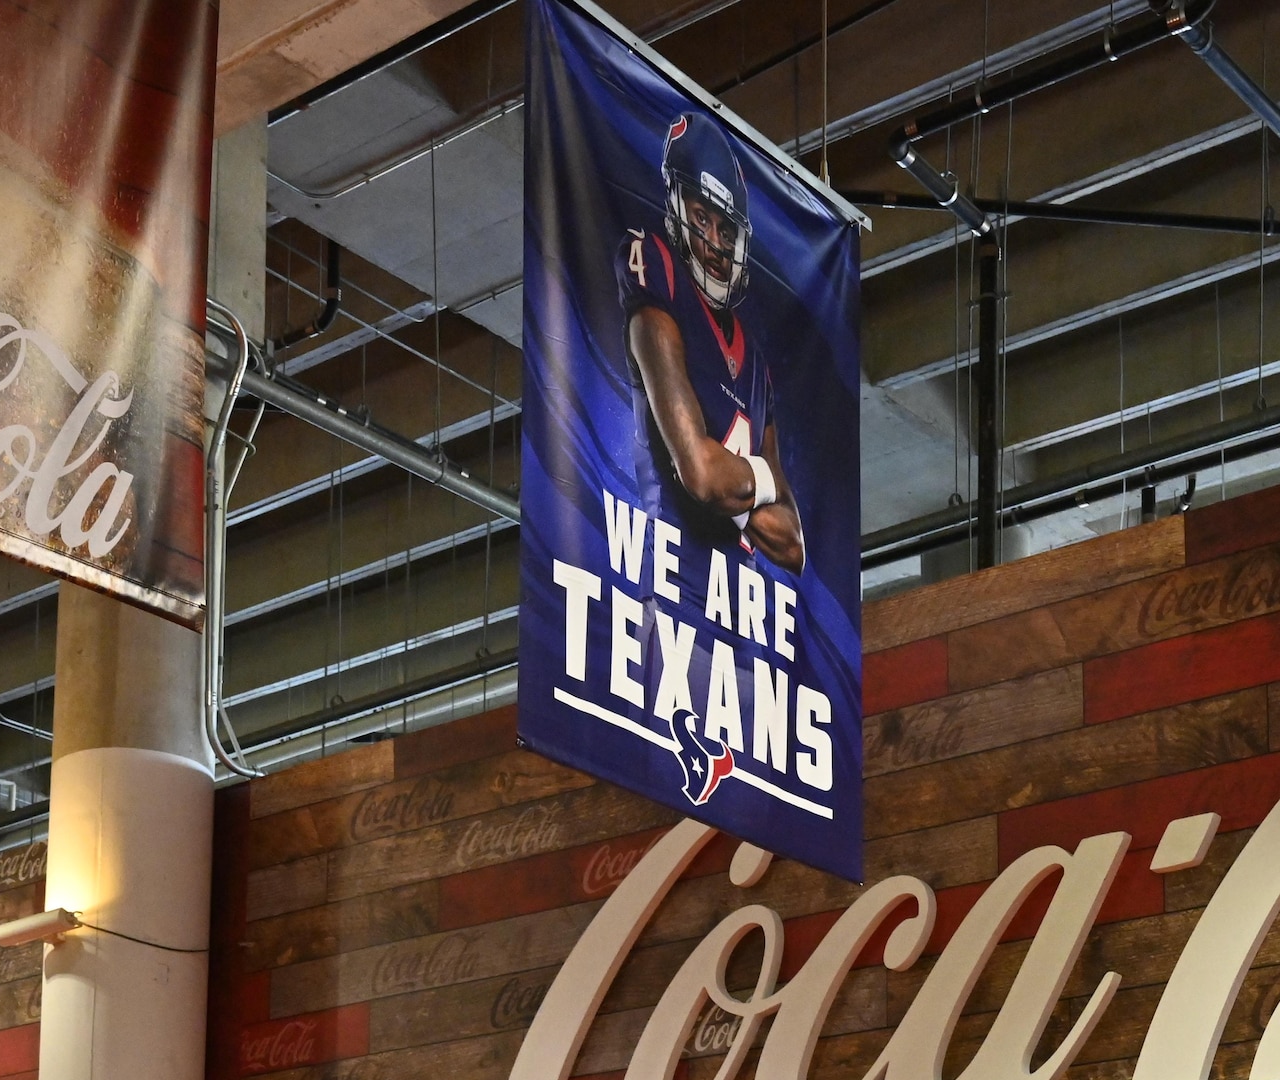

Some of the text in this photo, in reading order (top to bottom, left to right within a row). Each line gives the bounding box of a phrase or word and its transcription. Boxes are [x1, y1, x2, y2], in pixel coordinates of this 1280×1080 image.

[627, 228, 647, 287] 4
[602, 488, 797, 662] WE ARE
[552, 557, 834, 793] TEXANS
